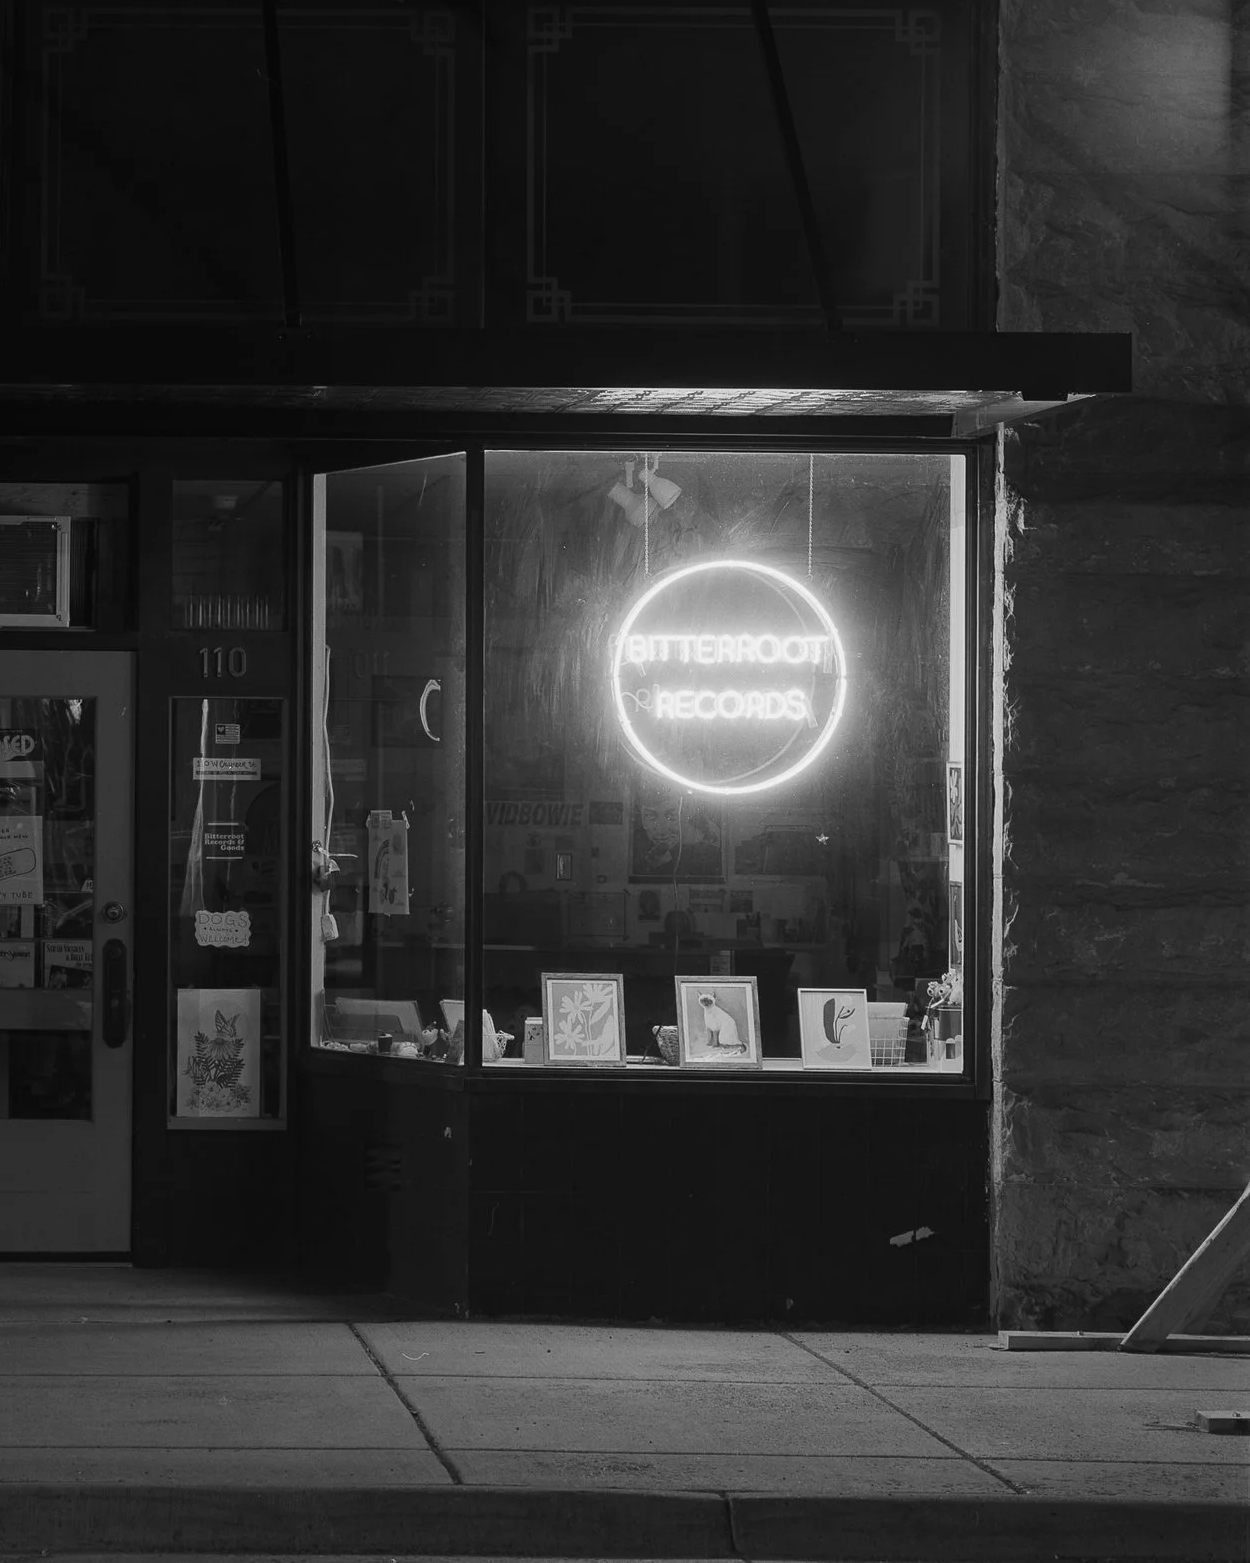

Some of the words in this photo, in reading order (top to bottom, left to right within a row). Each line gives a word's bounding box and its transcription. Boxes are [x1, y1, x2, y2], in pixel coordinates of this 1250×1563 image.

[199, 646, 247, 678] 110
[627, 633, 830, 664] BITTERROOT
[655, 689, 808, 721] RECORDS
[11, 891, 34, 899] TUBE
[198, 913, 248, 928] DOGS
